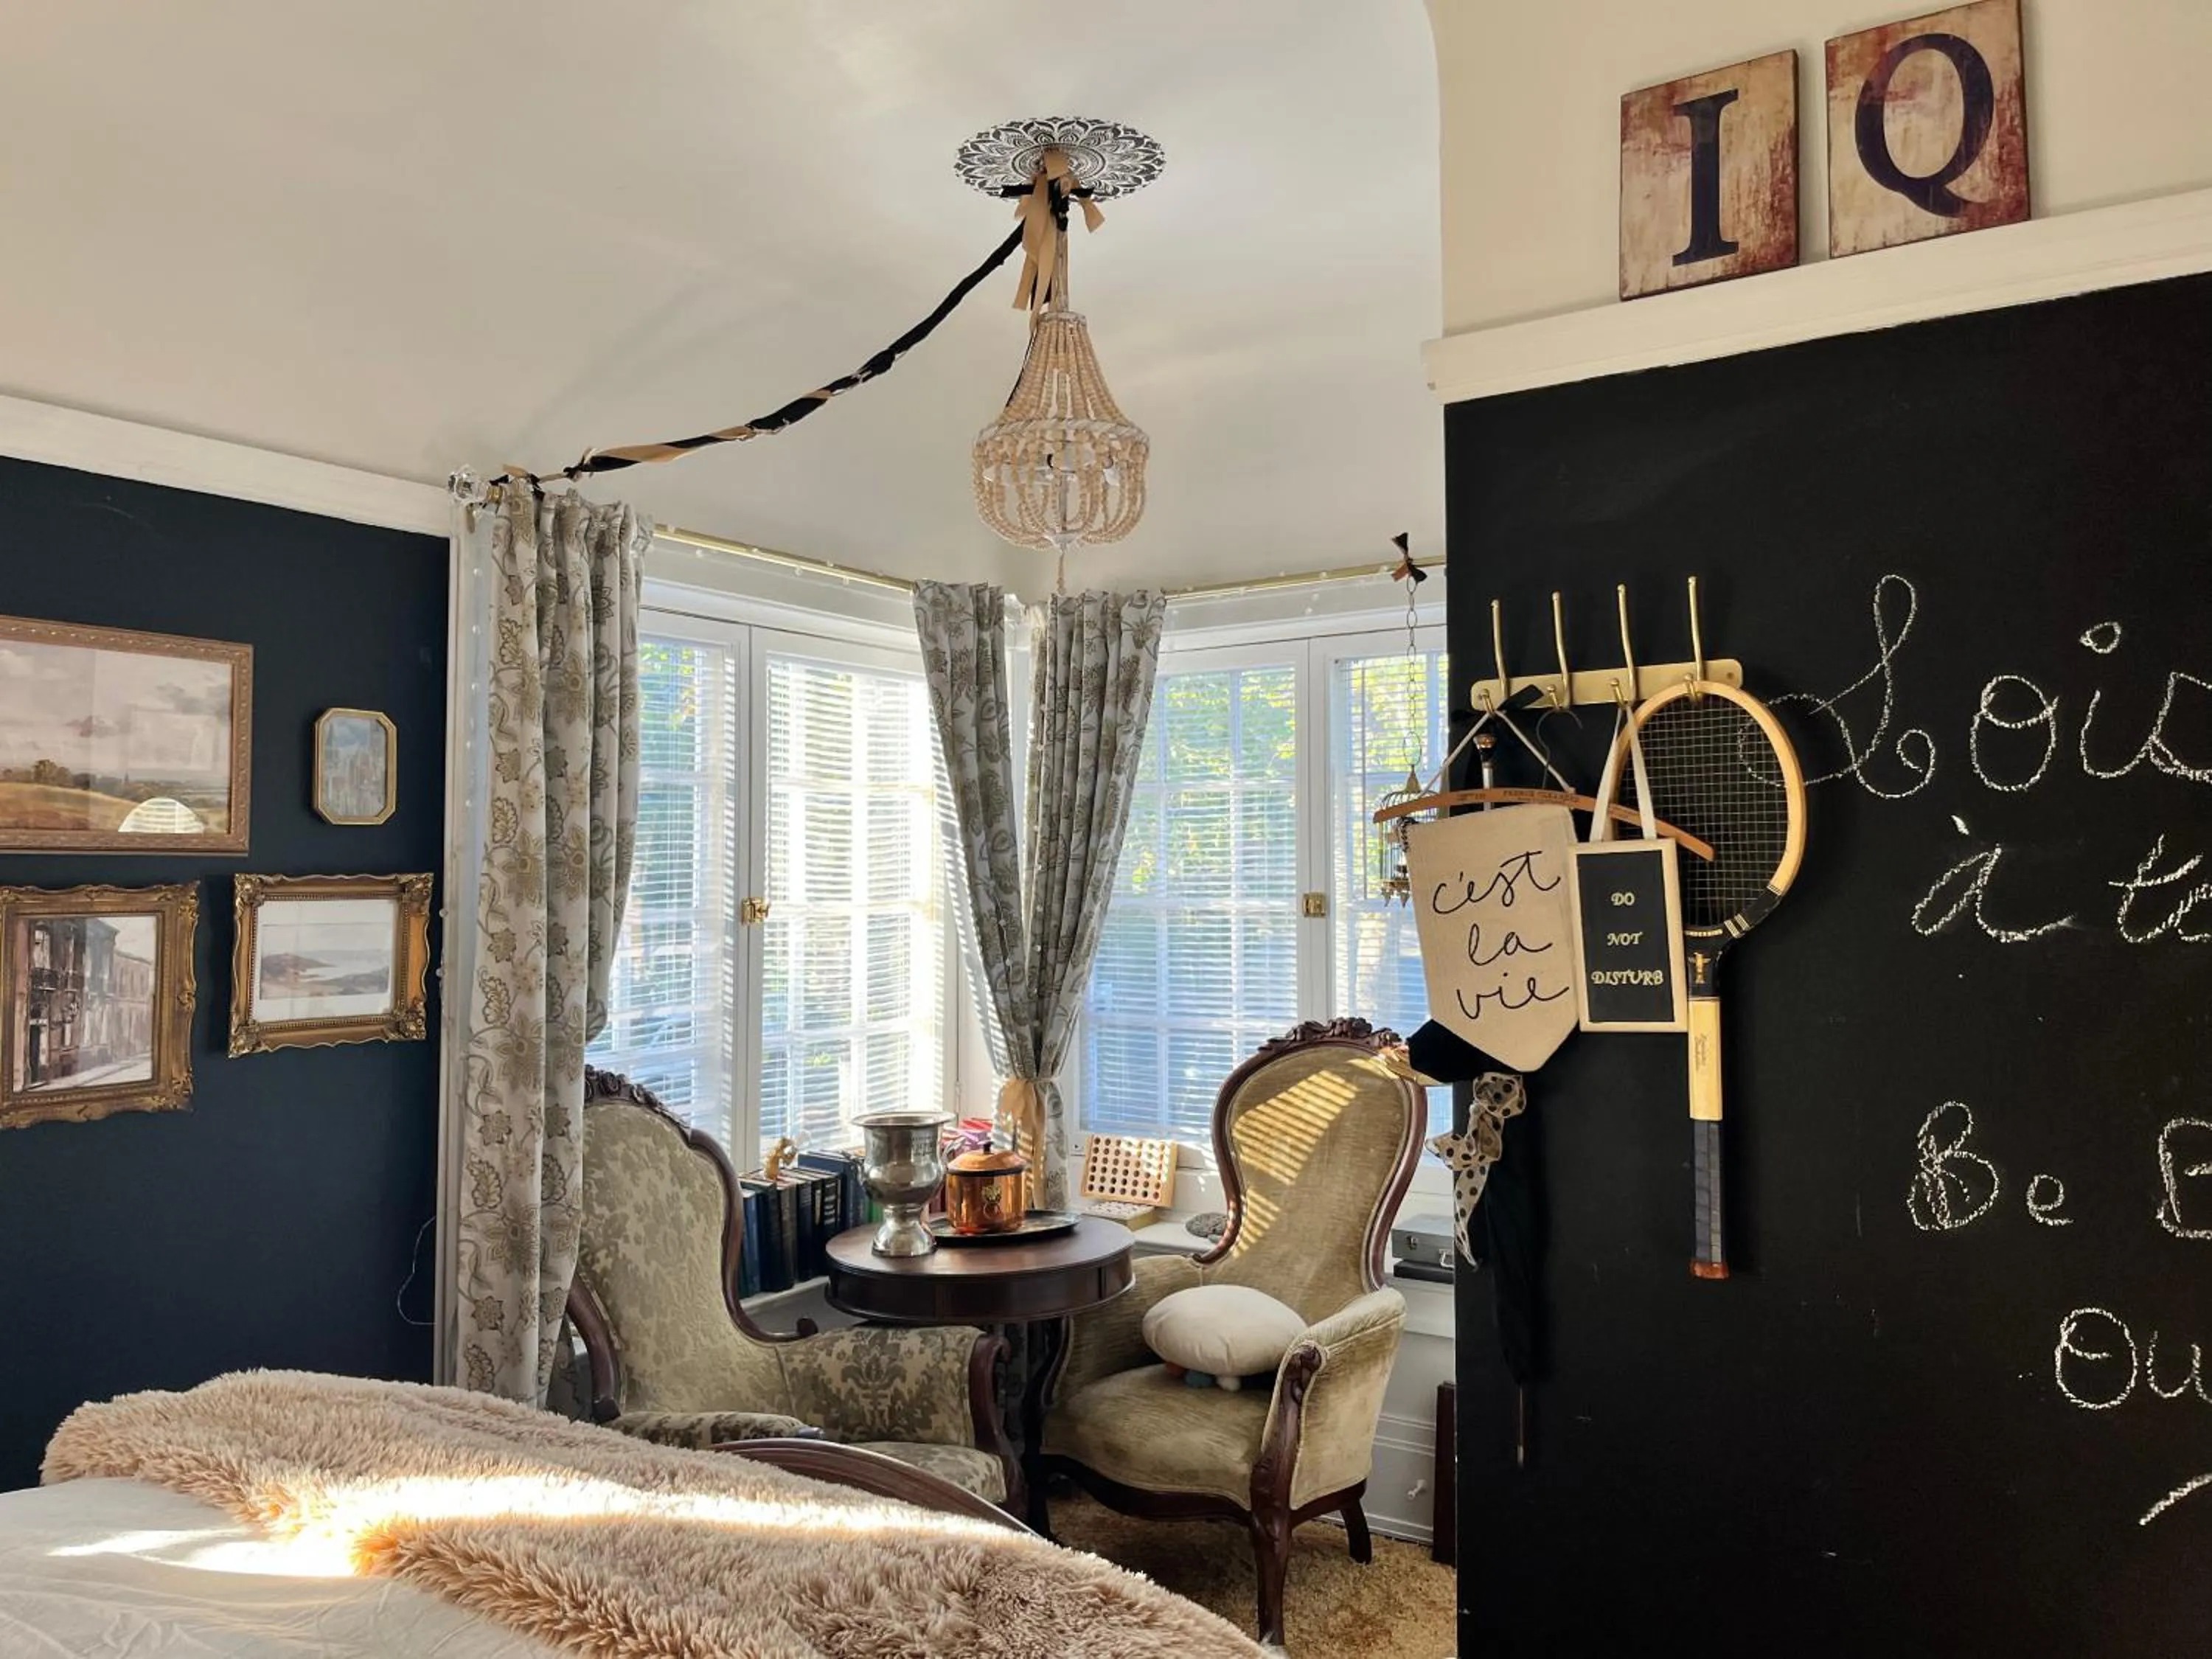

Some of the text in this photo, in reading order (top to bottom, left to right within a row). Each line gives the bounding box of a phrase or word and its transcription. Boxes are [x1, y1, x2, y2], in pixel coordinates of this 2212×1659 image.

[1432, 849, 1561, 915] c'est
[1610, 891, 1635, 907] DO
[1467, 922, 1553, 966] la
[1607, 931, 1644, 946] NOT
[1590, 969, 1664, 986] DISTURB
[1456, 972, 1570, 1020] vie
